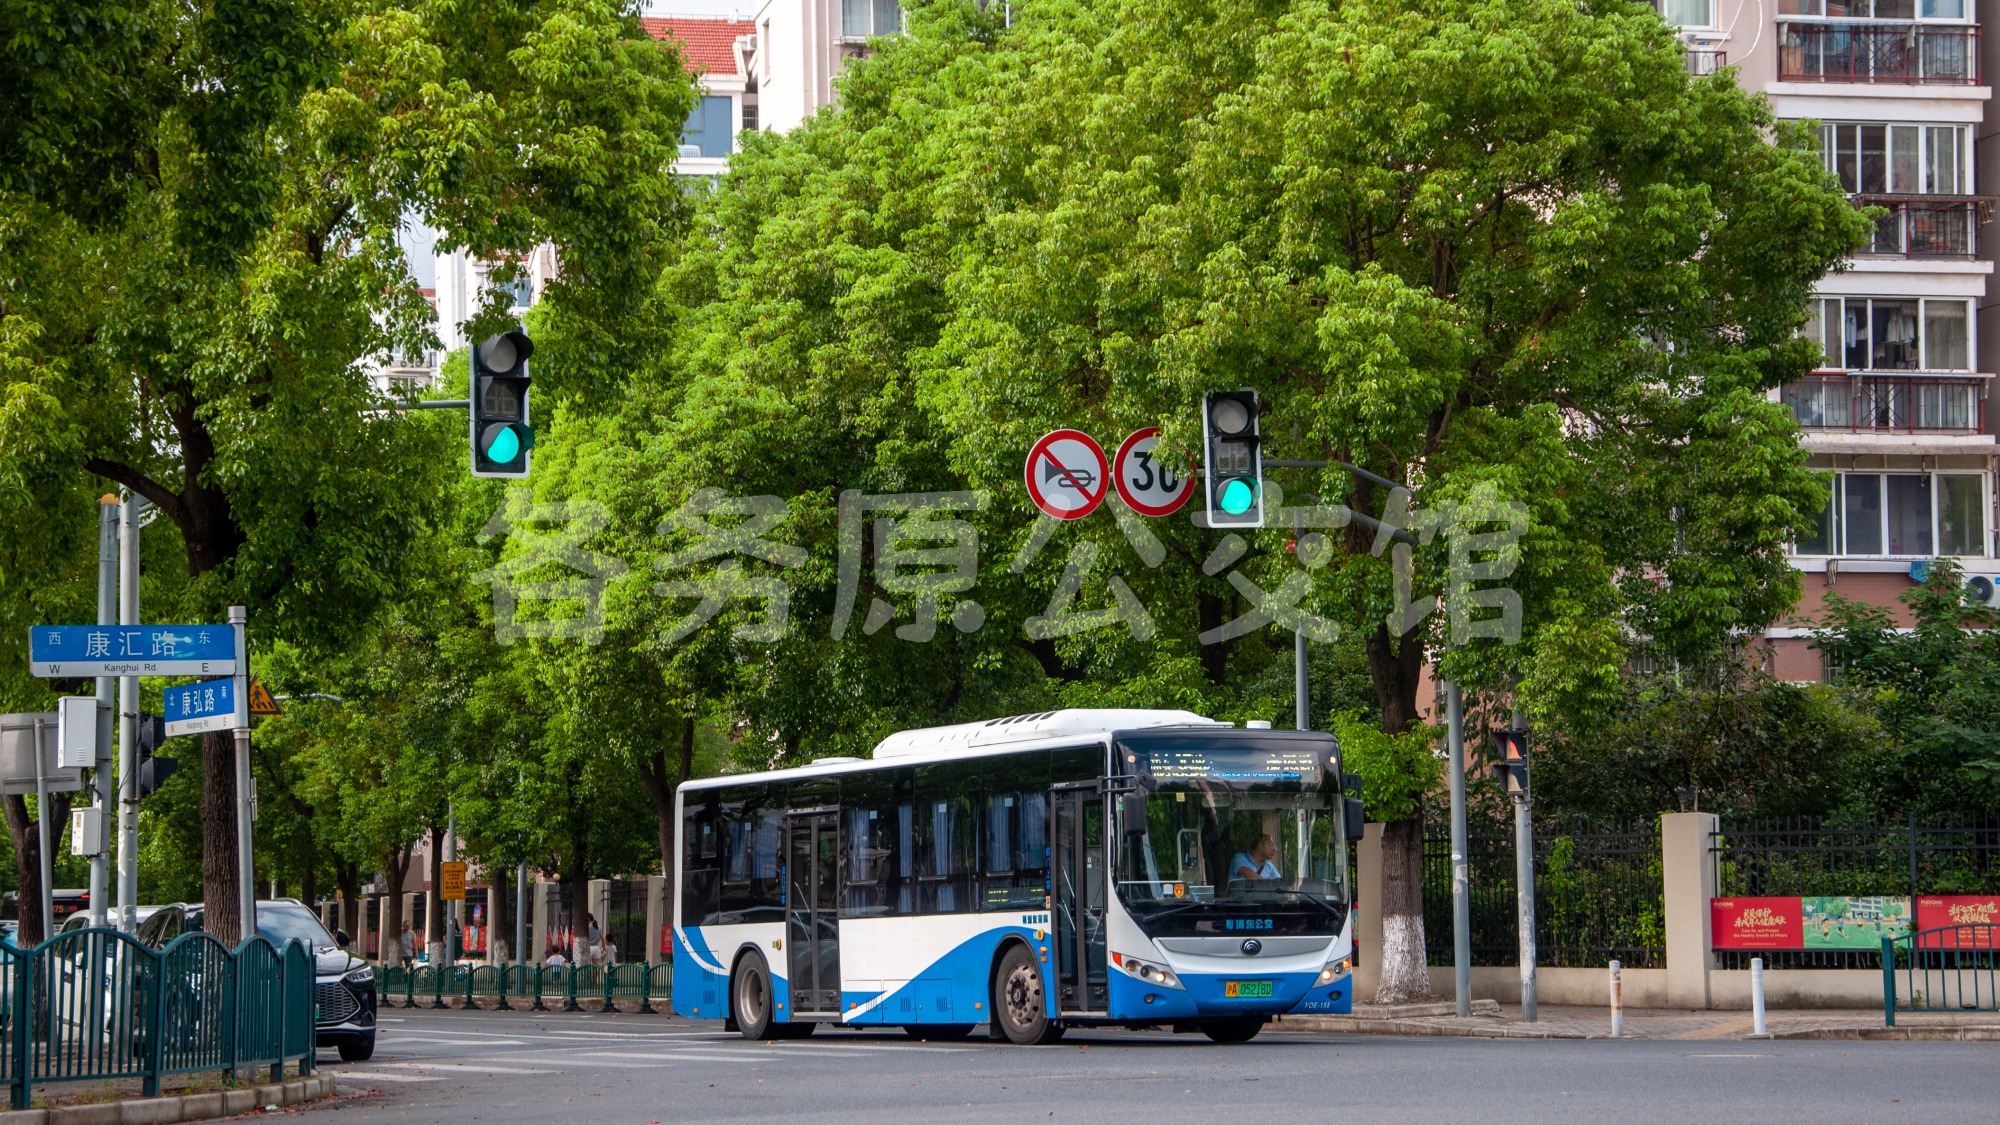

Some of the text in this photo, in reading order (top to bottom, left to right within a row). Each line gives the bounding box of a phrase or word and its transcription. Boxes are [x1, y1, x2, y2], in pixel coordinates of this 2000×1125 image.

[1132, 451, 1179, 494] 30
[48, 630, 211, 657] 西 康汇路 东
[49, 664, 61, 674] W
[104, 663, 139, 674] Kanghui
[201, 662, 209, 673] E
[182, 687, 215, 716] 康弘路
